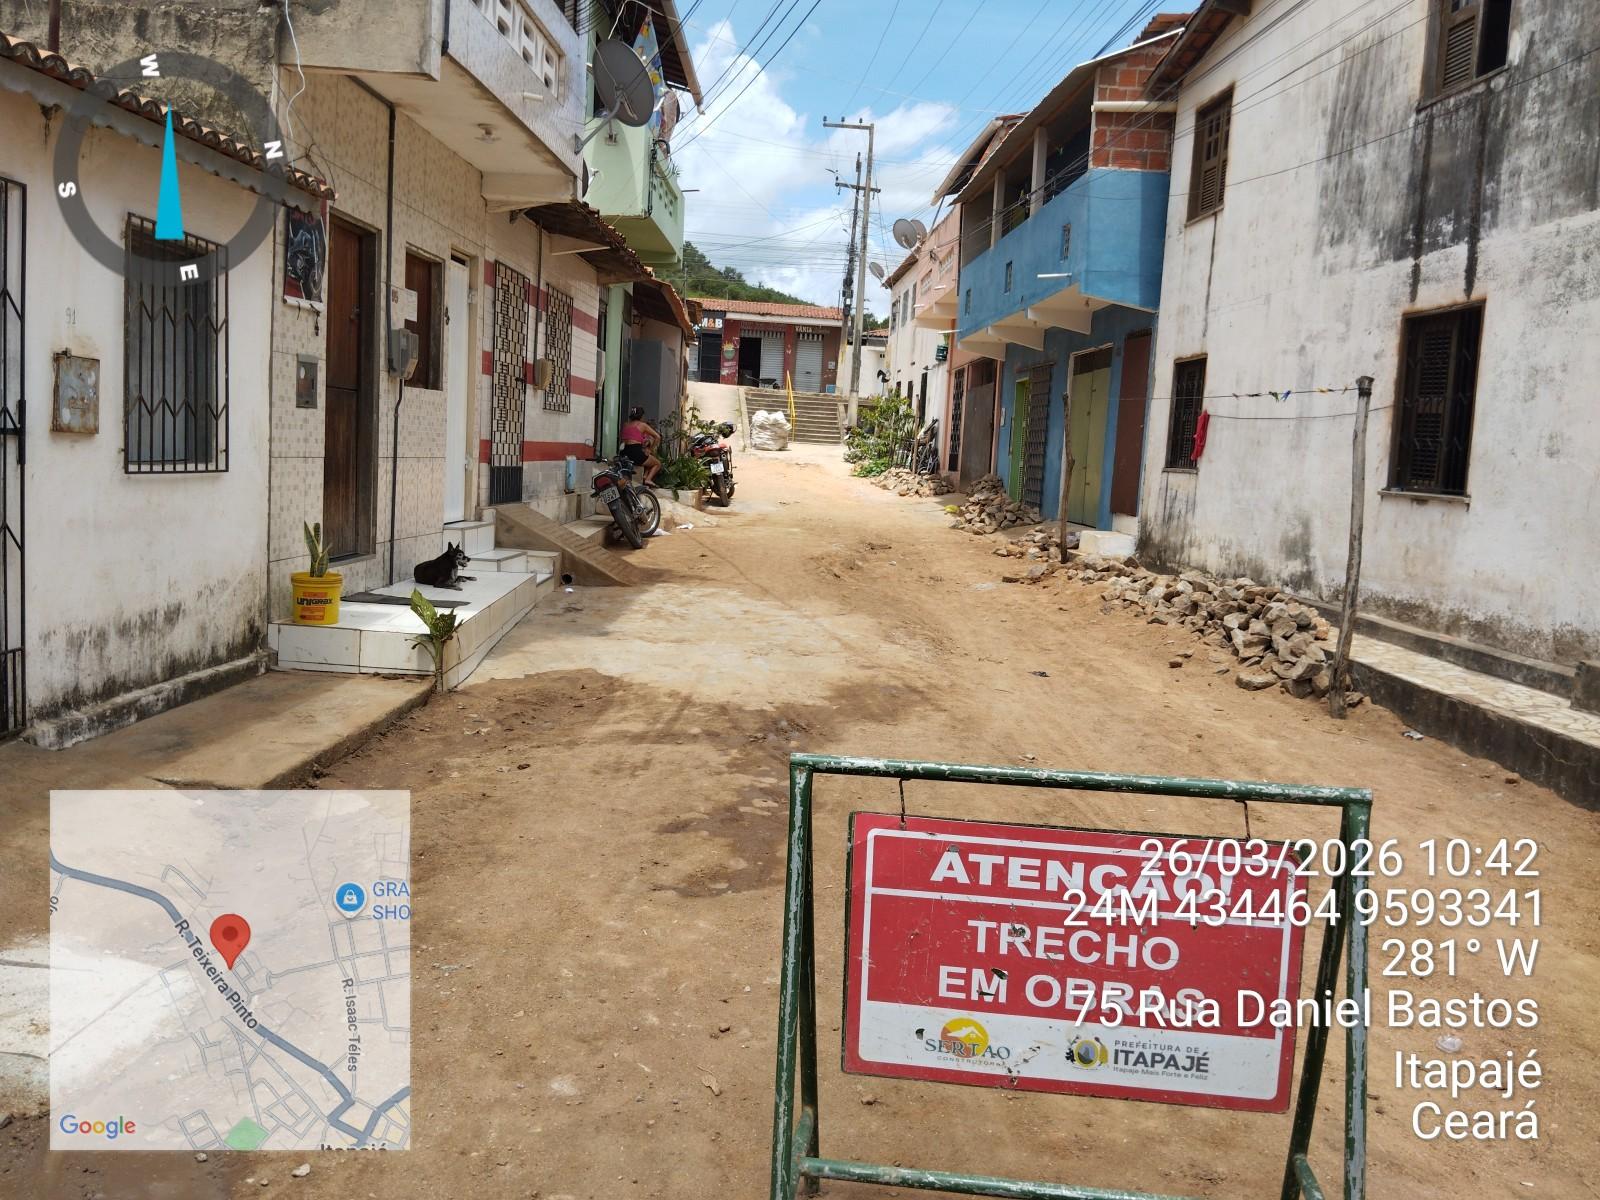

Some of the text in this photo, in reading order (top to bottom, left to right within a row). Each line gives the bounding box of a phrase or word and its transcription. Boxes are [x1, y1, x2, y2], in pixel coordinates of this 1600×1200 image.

[967, 918, 1180, 972] TRECHO
[937, 965, 1009, 1004] EM
[1113, 1048, 1210, 1074] ITAPAJÉ
[1114, 1039, 1200, 1054] PREFEITURA DE
